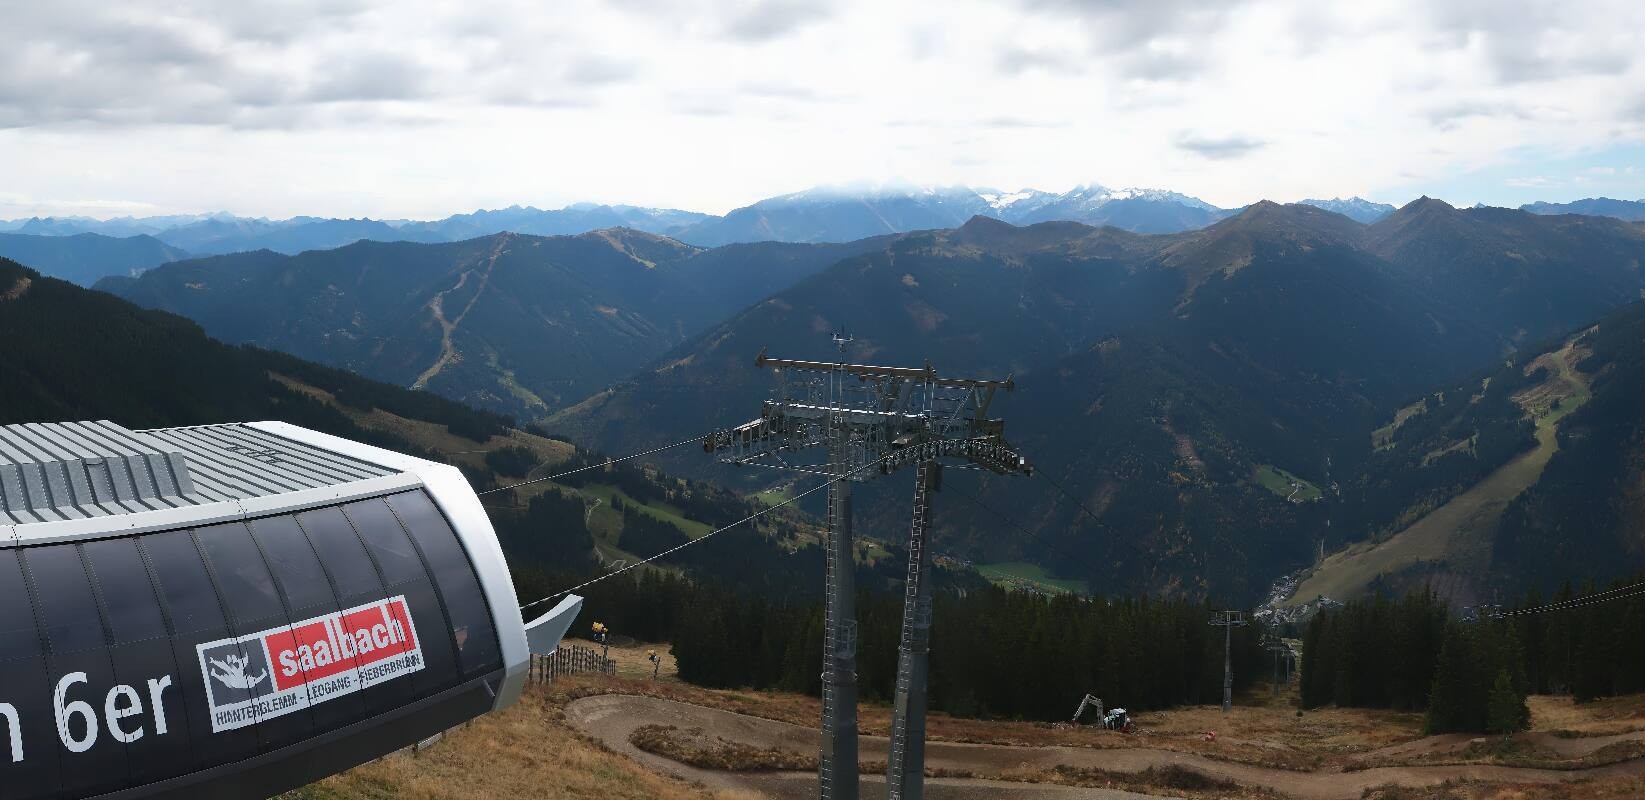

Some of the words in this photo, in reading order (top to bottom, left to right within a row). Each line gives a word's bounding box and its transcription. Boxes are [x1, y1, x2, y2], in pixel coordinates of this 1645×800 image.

[278, 602, 406, 677] saalbach
[53, 671, 172, 753] 6er
[307, 676, 351, 701] LEOGANG
